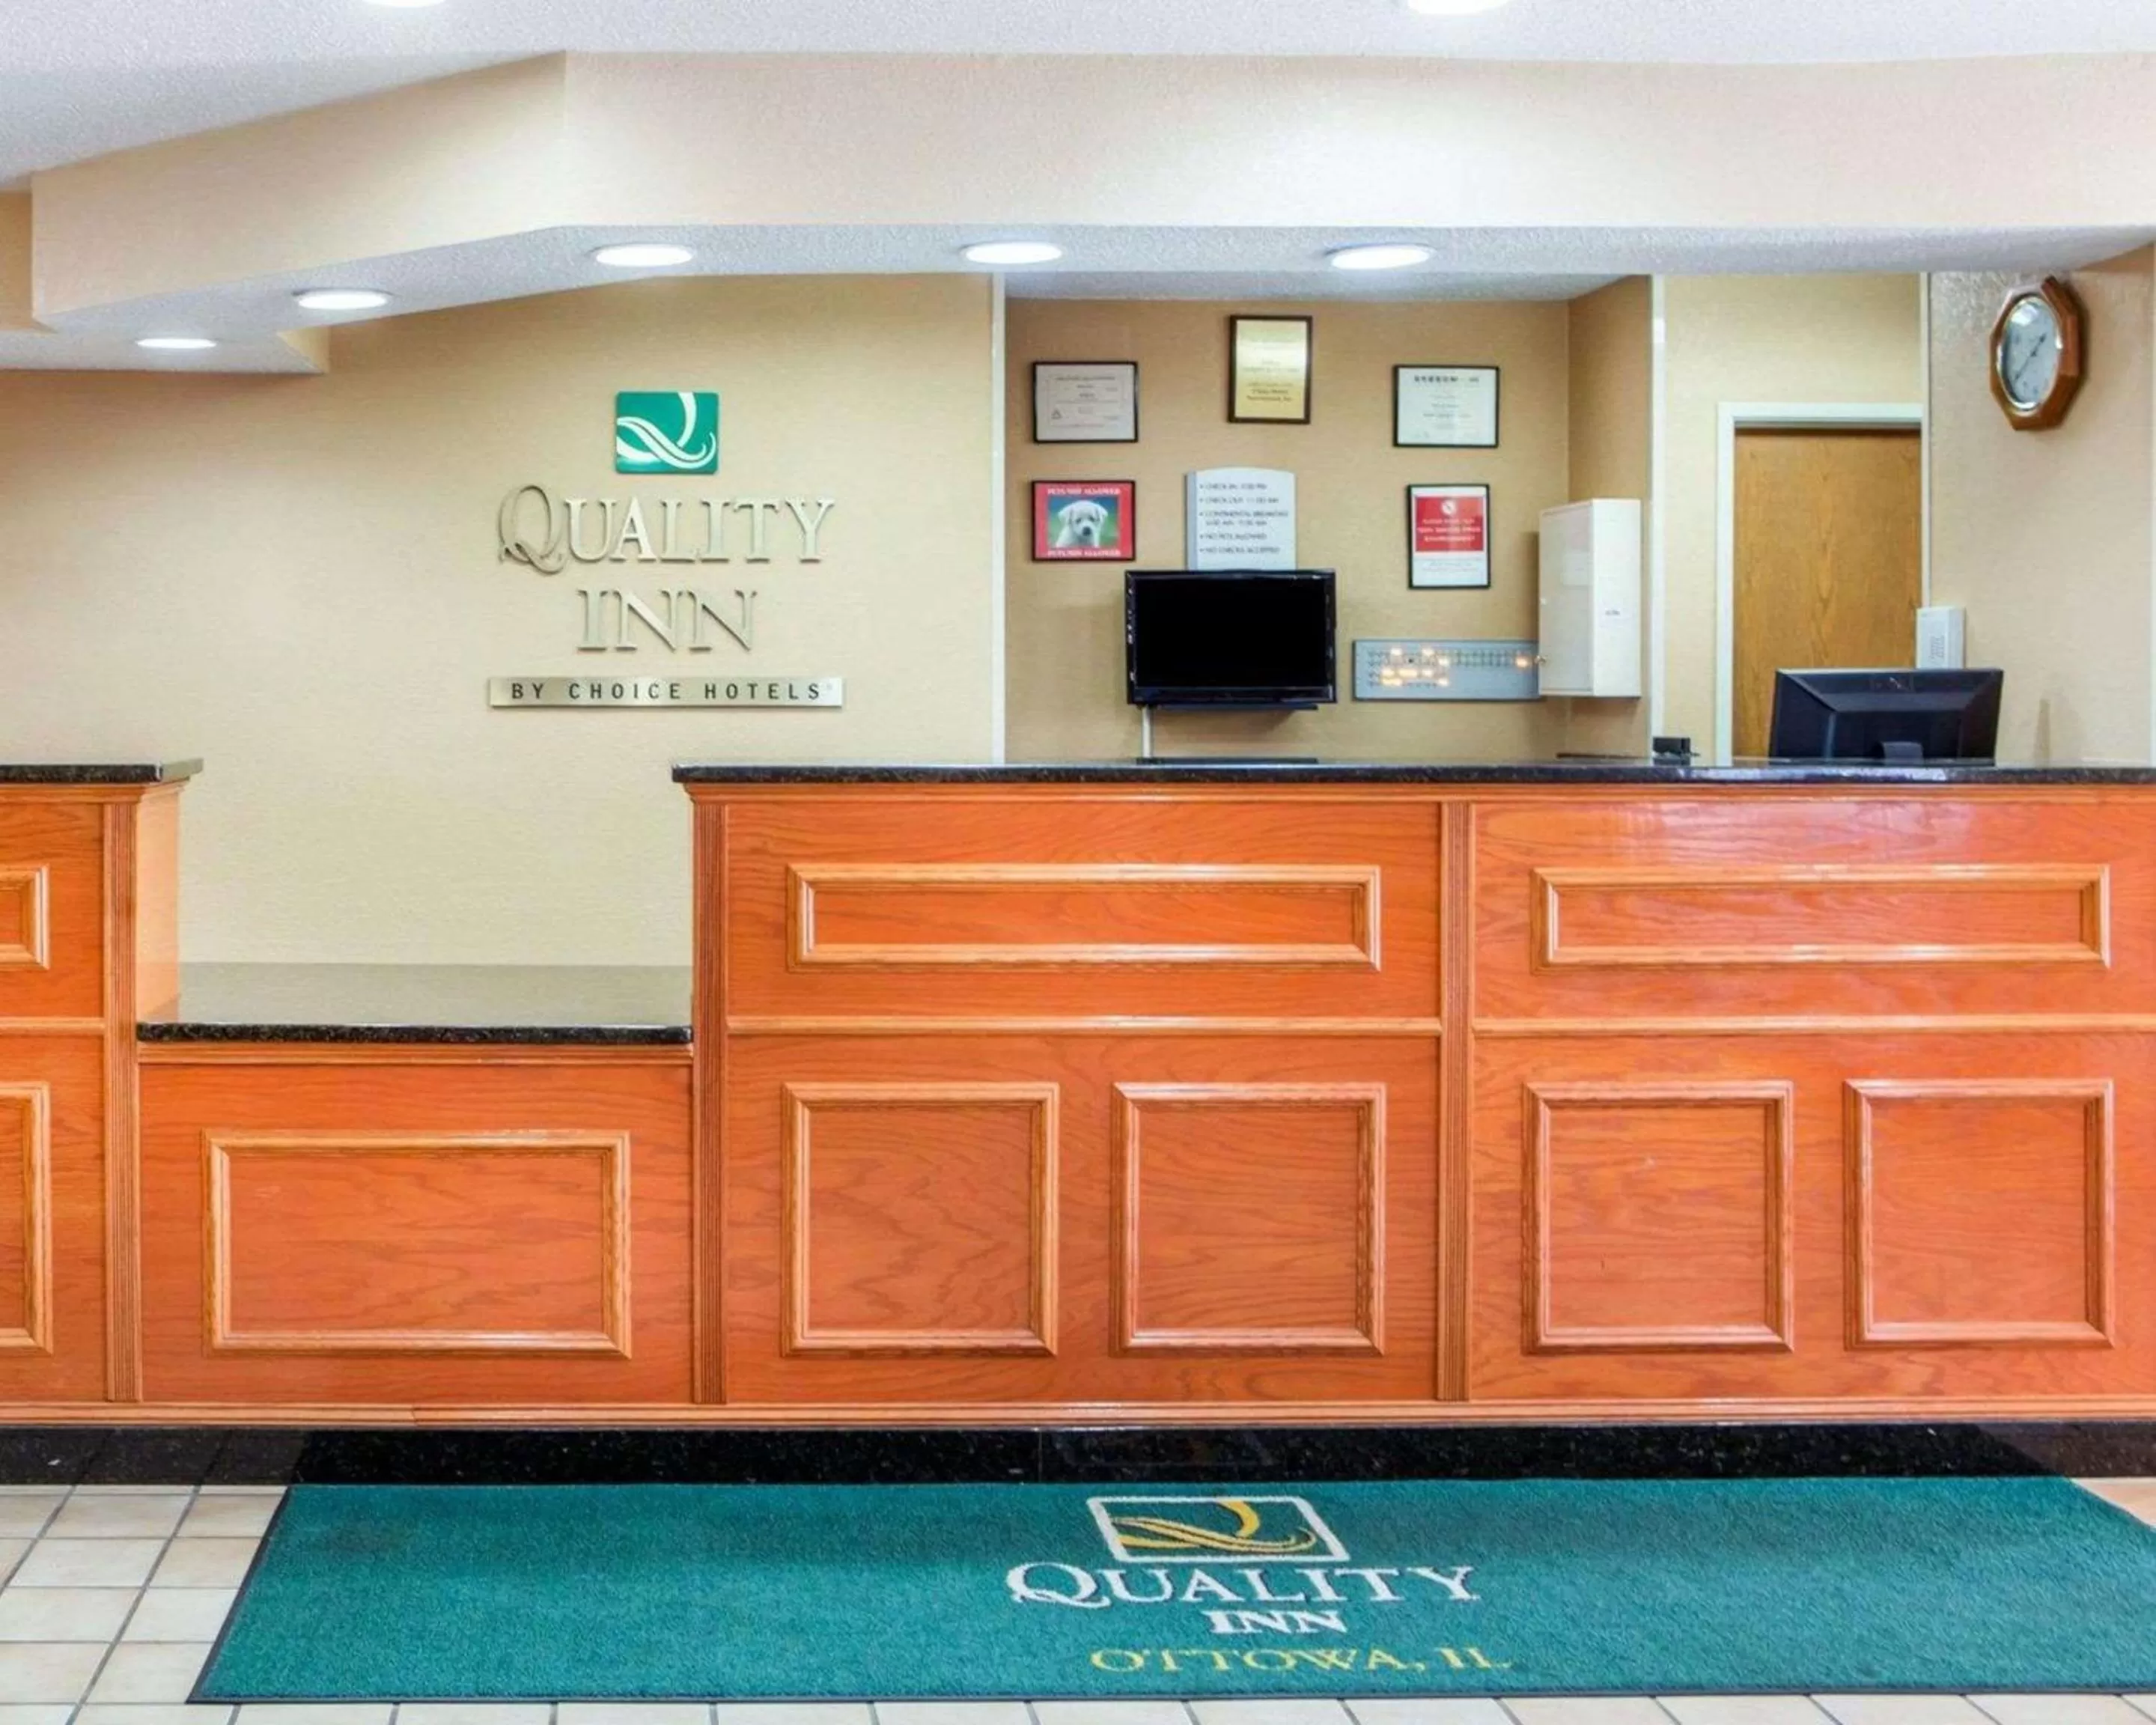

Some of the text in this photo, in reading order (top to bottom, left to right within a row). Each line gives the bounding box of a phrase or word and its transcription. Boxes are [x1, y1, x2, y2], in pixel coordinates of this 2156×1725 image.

[498, 484, 835, 576] QUALITY
[576, 589, 758, 652] INN
[511, 683, 820, 700] BY CHOICE HOTELS
[1006, 1563, 1481, 1609] QUALITY
[1201, 1610, 1348, 1634] INN
[1433, 1646, 1512, 1670] IL
